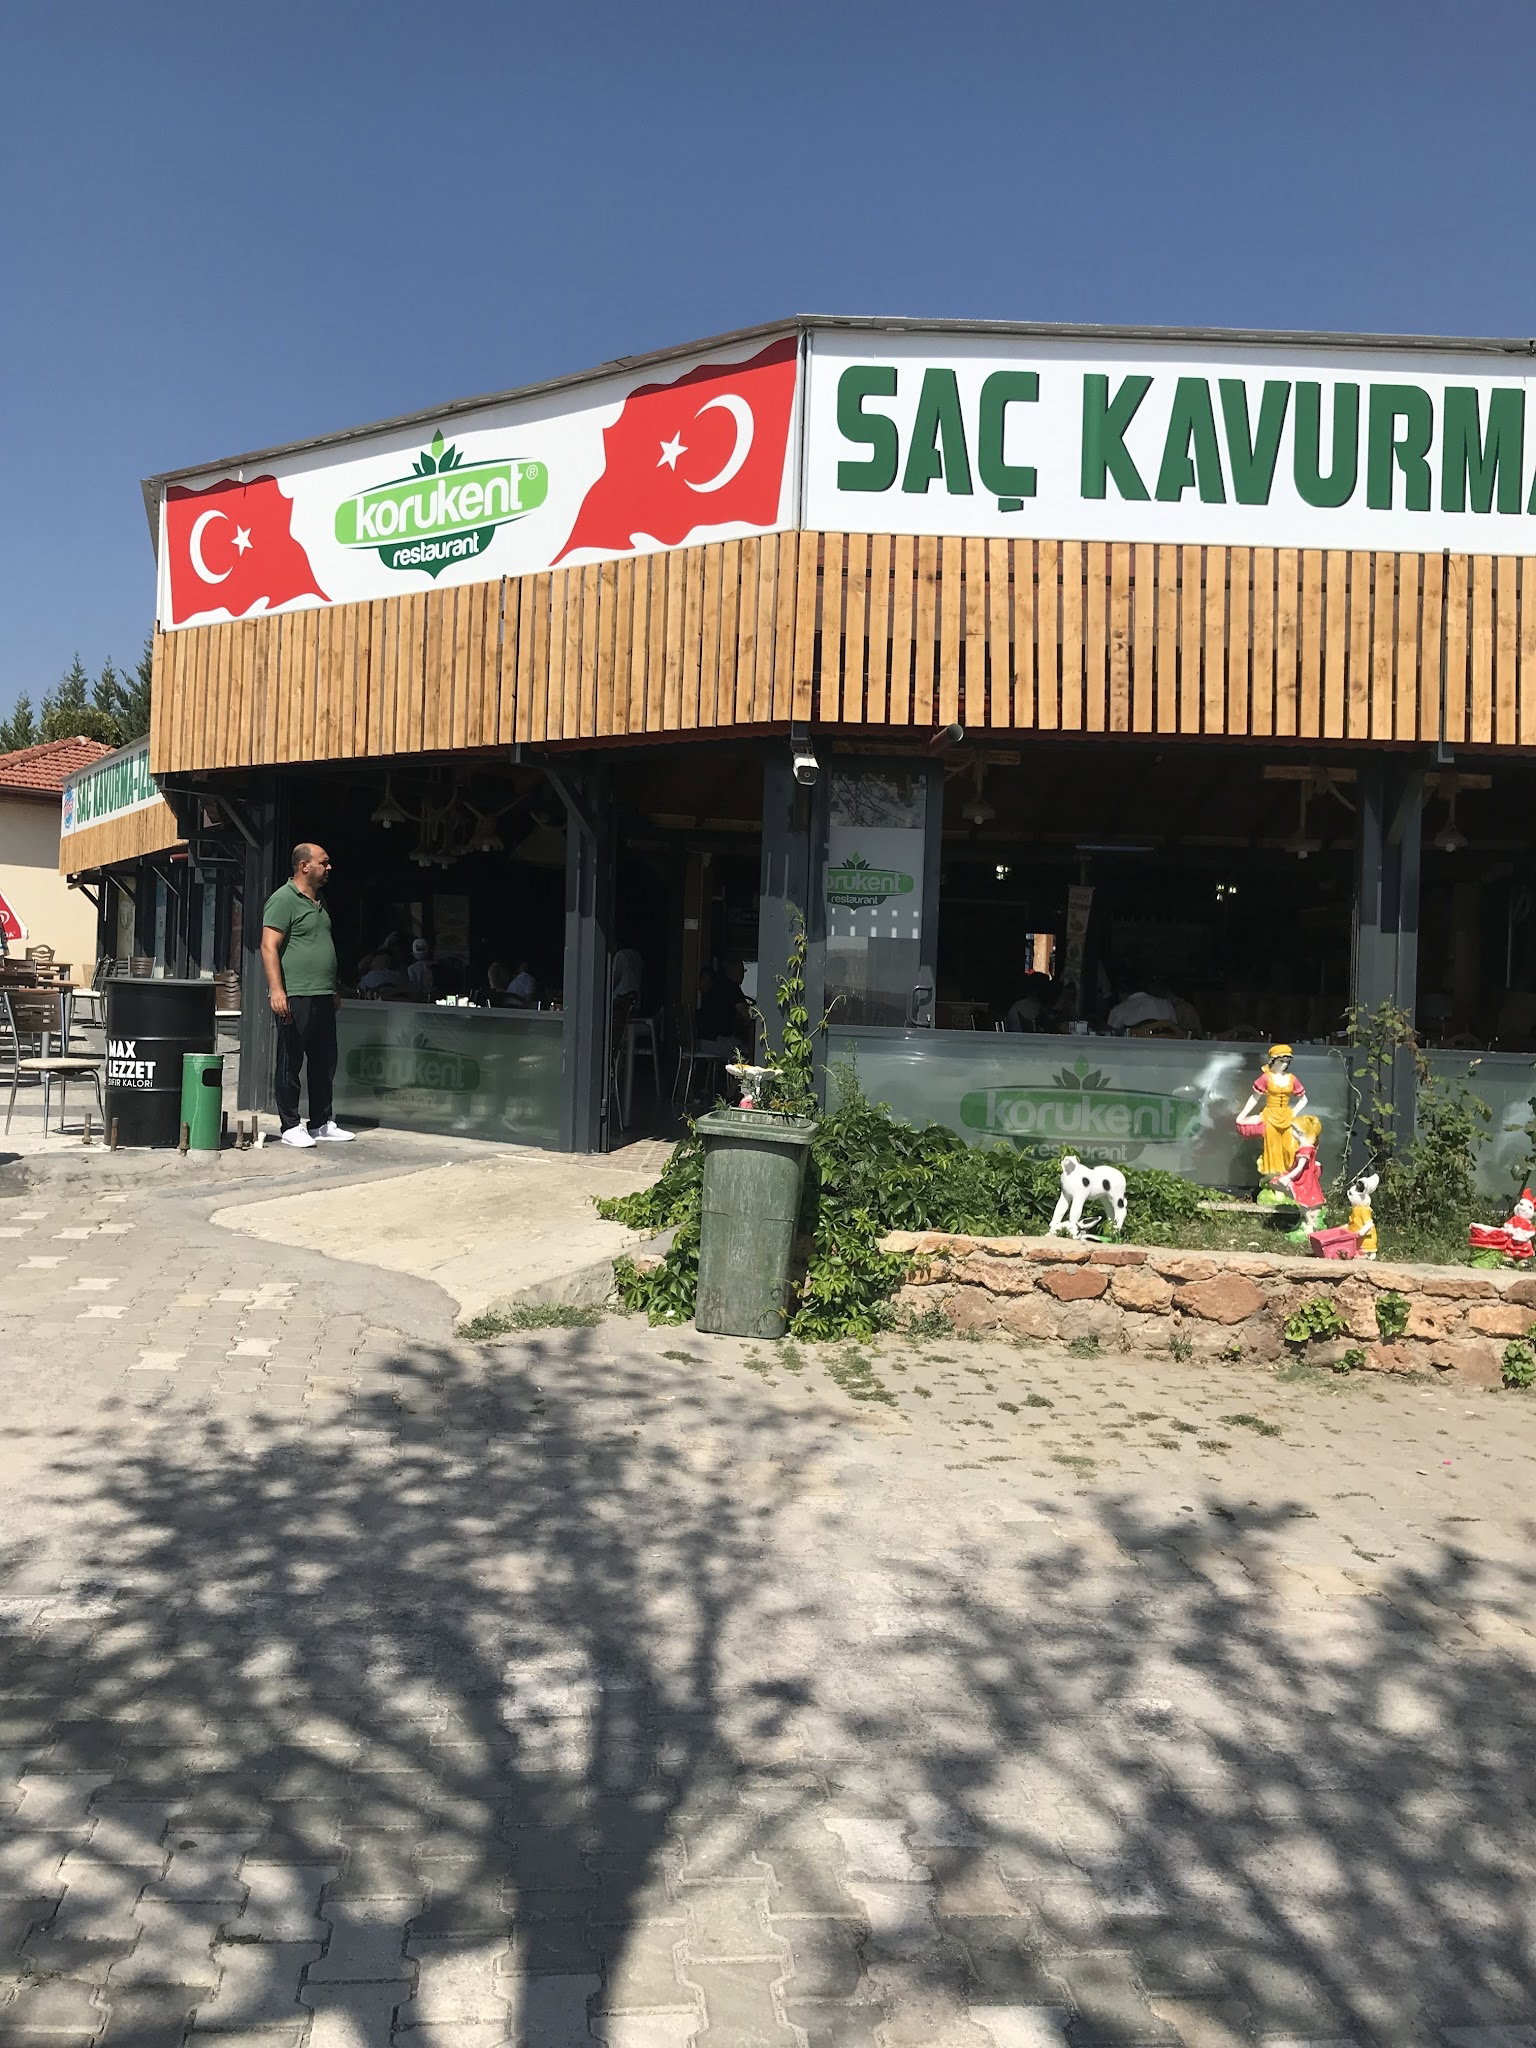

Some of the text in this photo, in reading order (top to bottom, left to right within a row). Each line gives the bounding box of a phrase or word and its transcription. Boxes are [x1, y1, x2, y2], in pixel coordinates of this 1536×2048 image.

[837, 365, 1536, 516] SAÇ KAVURM
[356, 463, 523, 540] korukent
[393, 531, 480, 567] restaurant
[827, 870, 902, 892] orukent
[830, 894, 879, 905] restaurant
[108, 1059, 157, 1080] LEZZET
[986, 1091, 1175, 1136] korukent
